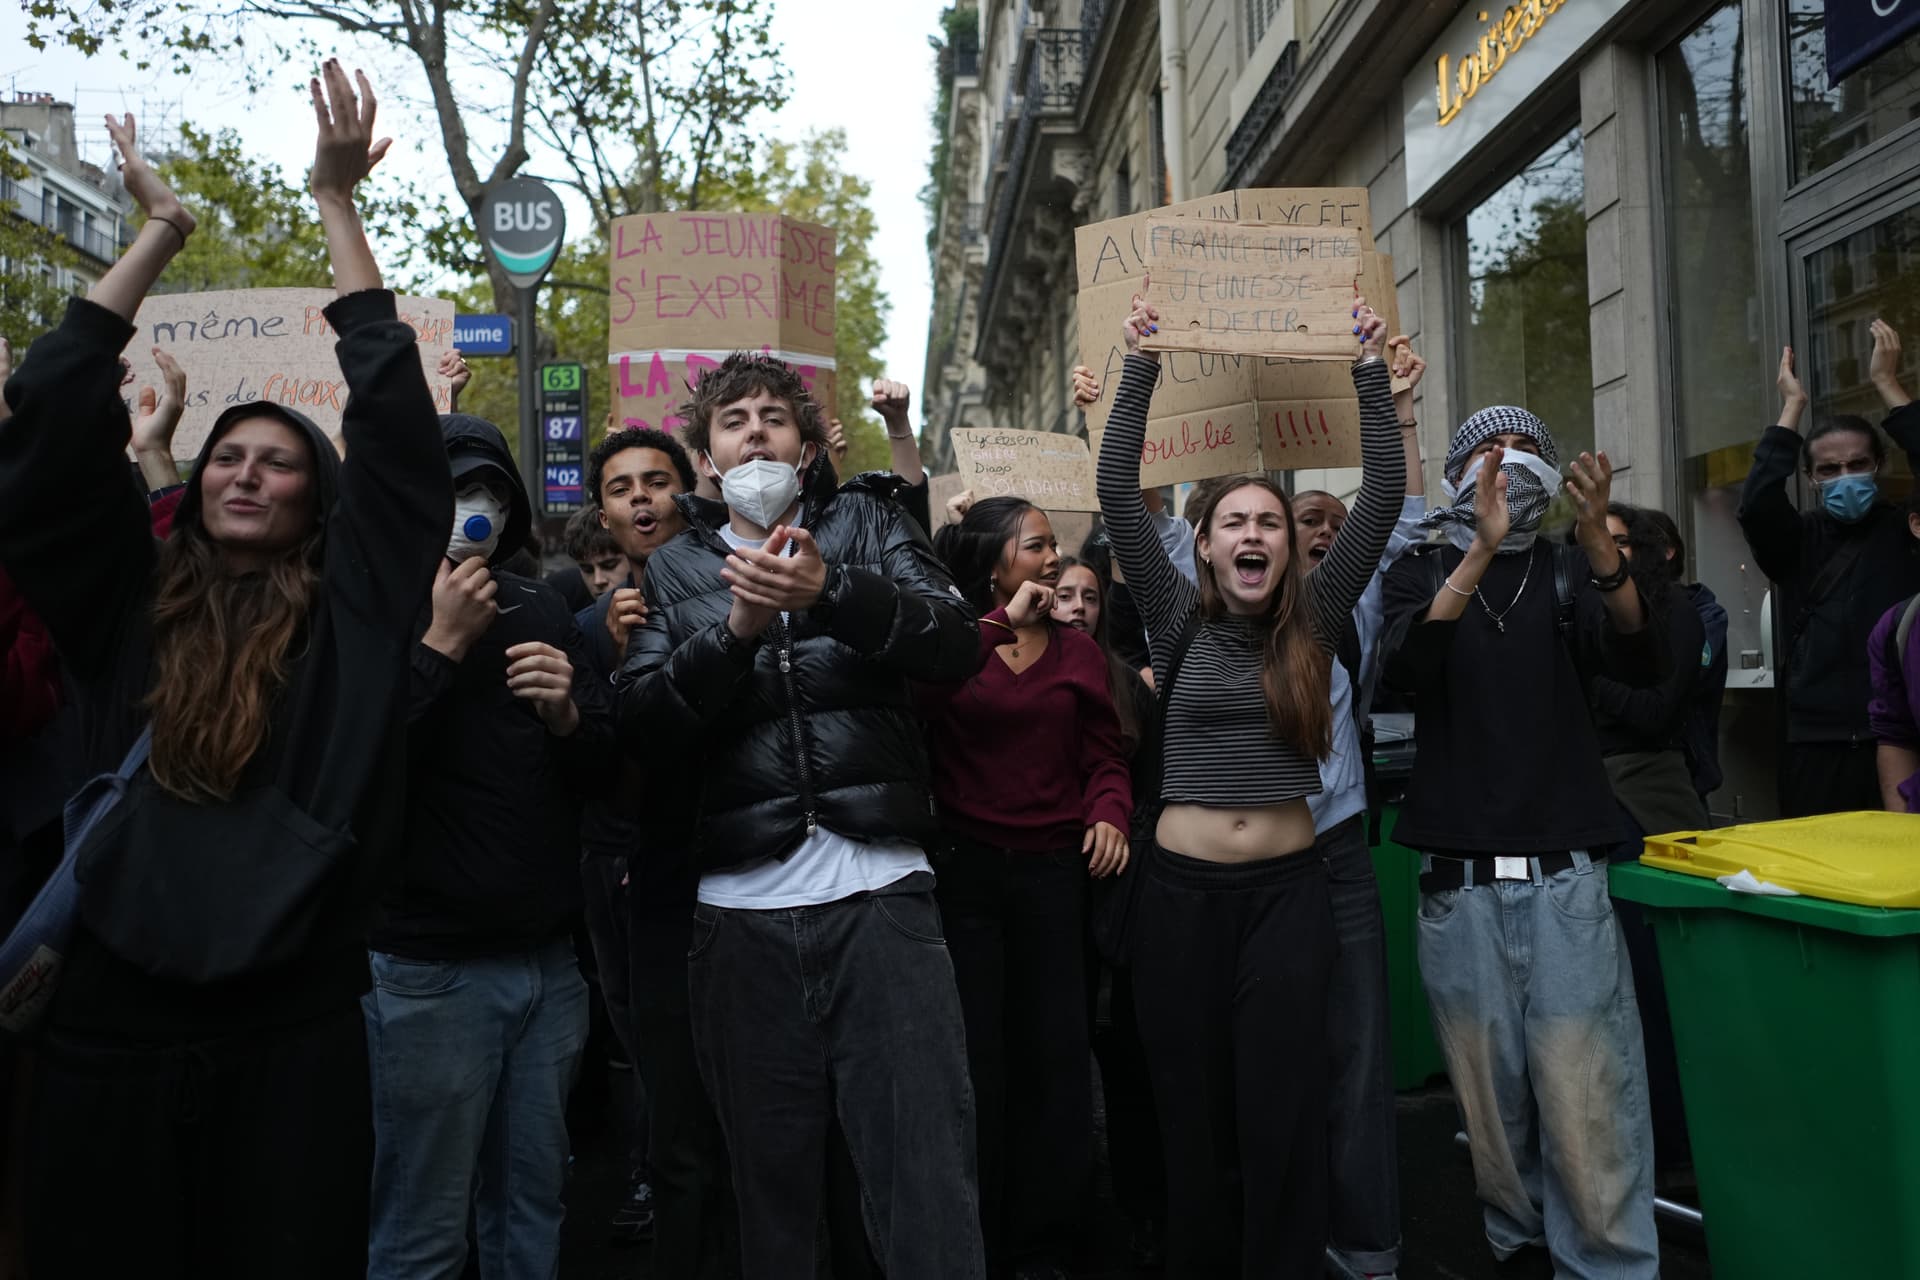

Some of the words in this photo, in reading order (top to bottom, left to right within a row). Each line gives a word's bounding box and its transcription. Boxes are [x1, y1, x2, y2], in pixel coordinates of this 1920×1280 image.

[493, 202, 553, 231] BUS
[616, 219, 663, 259] LA
[679, 216, 835, 274] JEUNESSE
[1168, 268, 1313, 303] JEUNESSE
[152, 309, 289, 344] même
[453, 326, 503, 343] aume
[1207, 307, 1300, 335] DETER
[548, 368, 575, 388] 63
[619, 351, 671, 398] LA
[226, 377, 258, 404] de
[262, 373, 345, 412] CHOIX
[548, 417, 577, 439] 87
